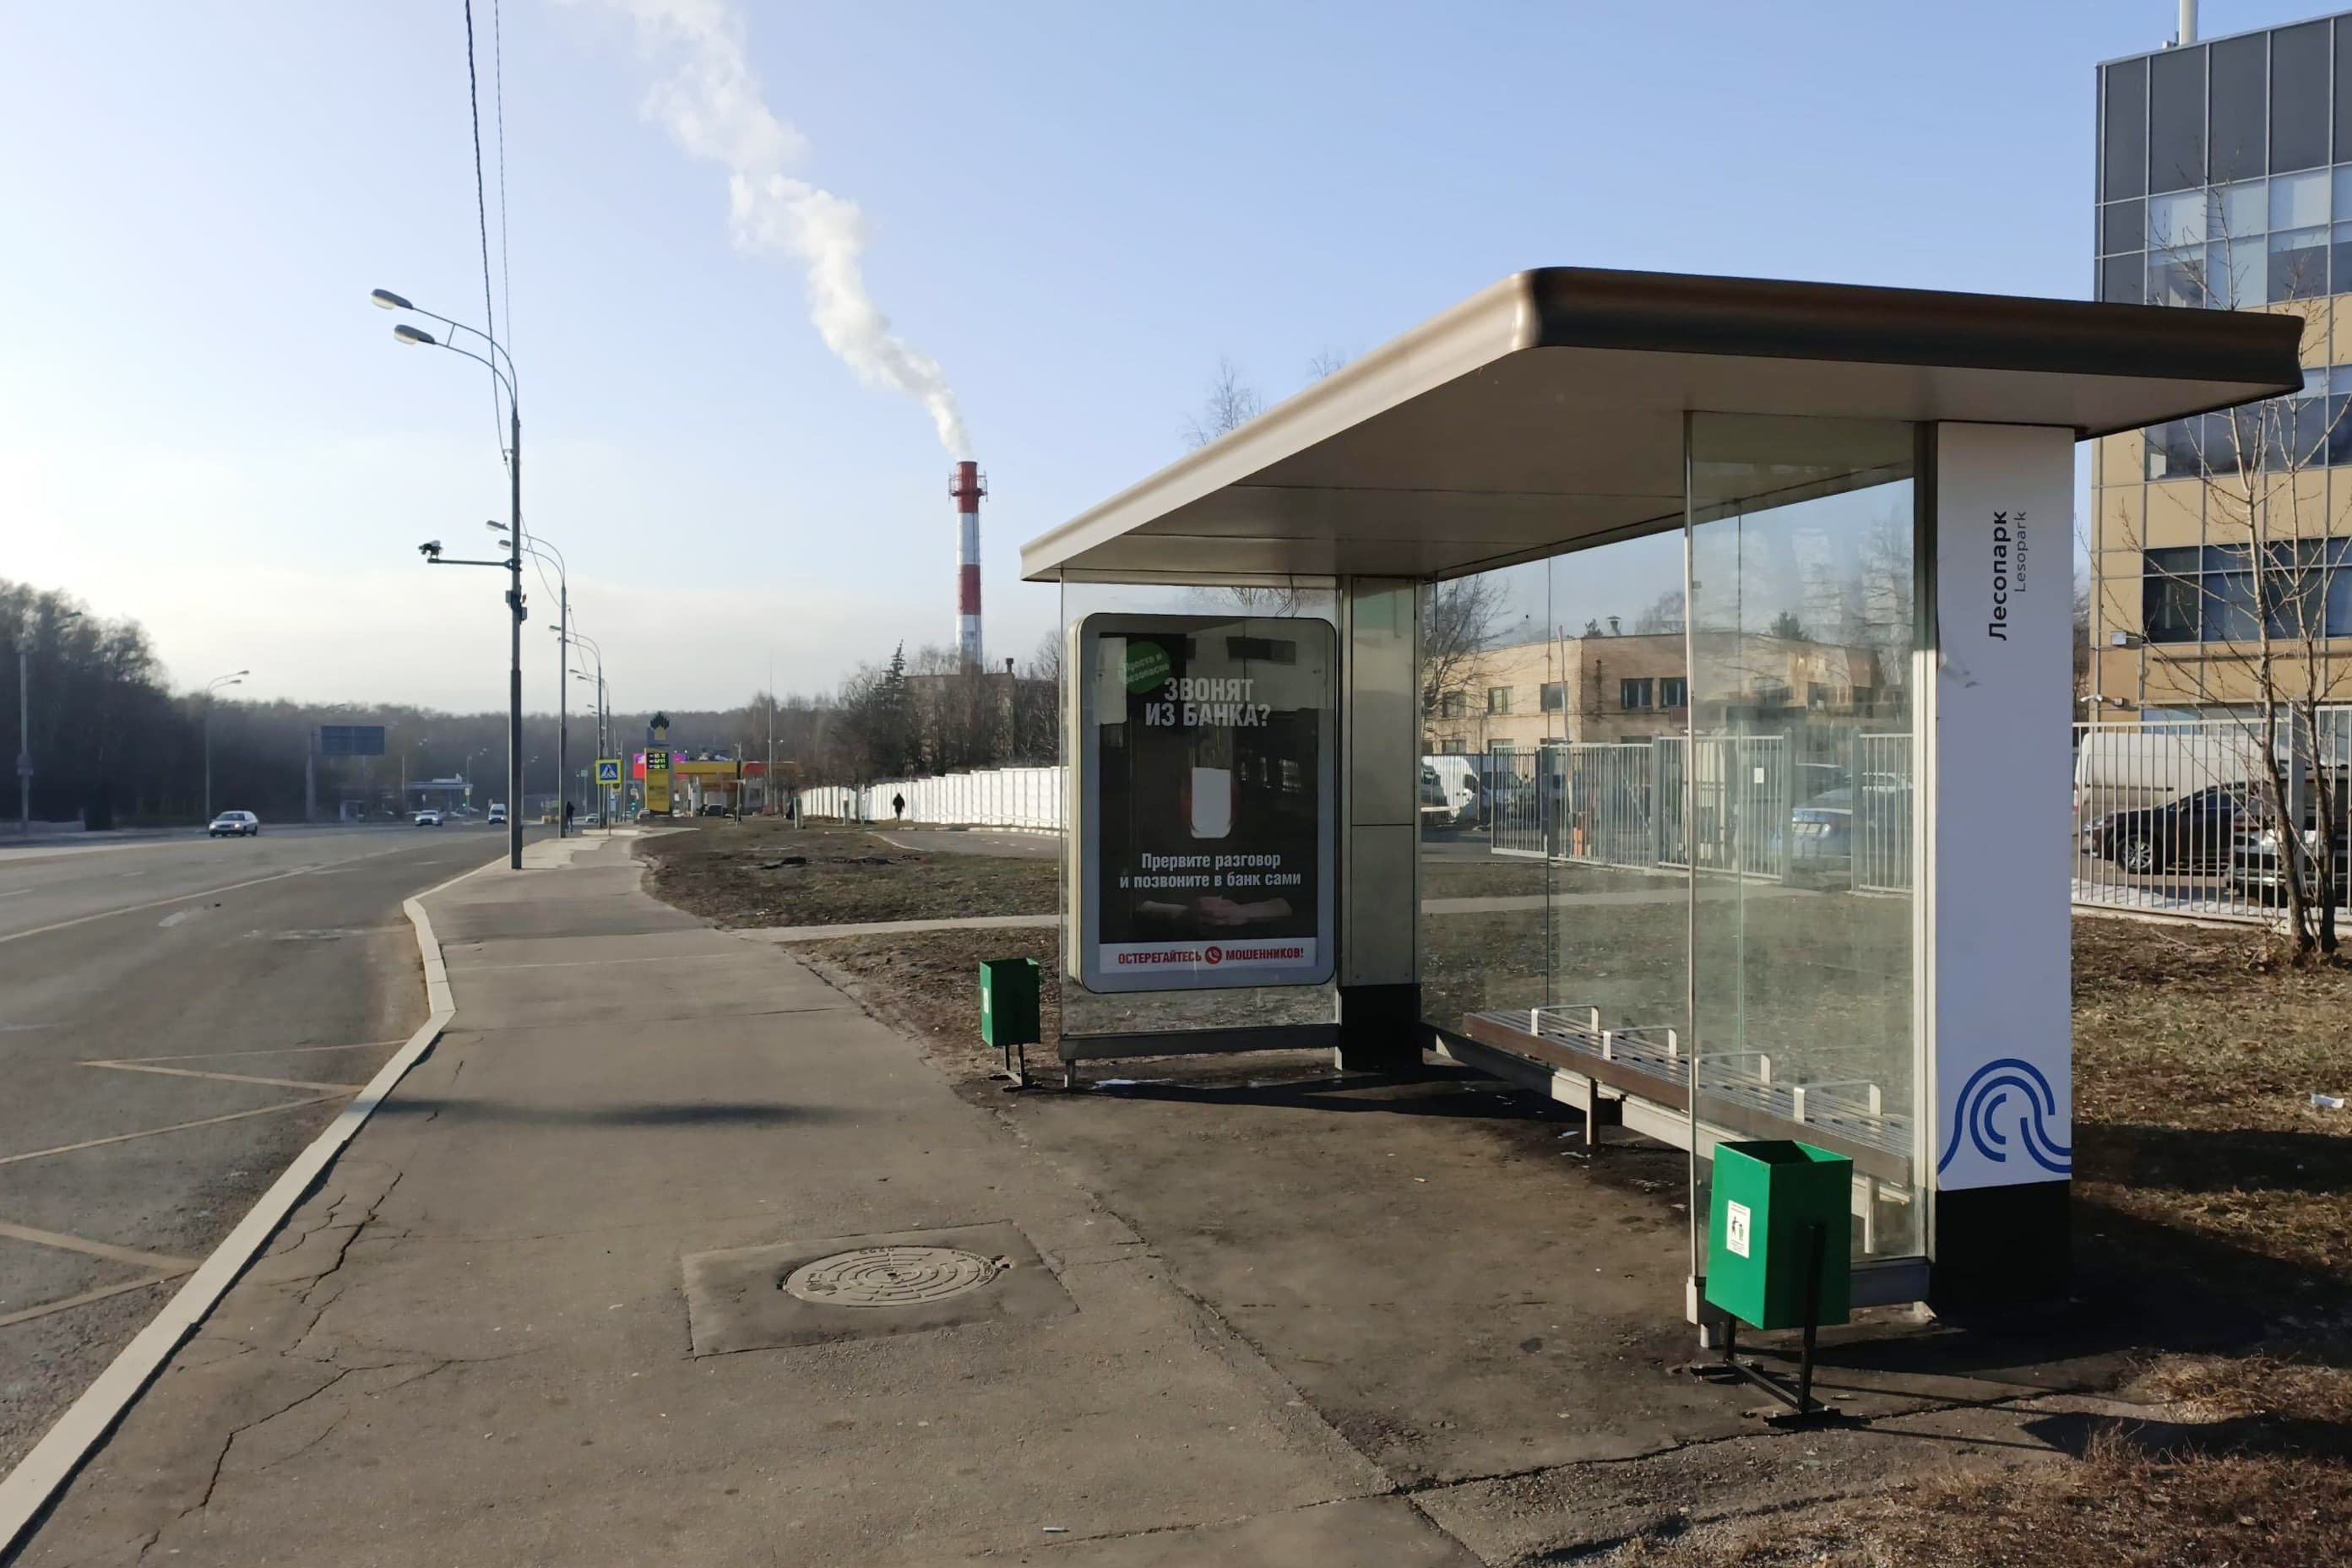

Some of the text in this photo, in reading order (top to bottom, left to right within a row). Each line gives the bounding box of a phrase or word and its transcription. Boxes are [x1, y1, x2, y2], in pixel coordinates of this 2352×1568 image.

[2013, 511, 2029, 592] Lesopark
[1989, 511, 2011, 641] Лесопарк
[1164, 676, 1254, 702] ЗВОНЯТ
[1145, 703, 1271, 727] ИЗ БАНКА?
[1142, 853, 1281, 871] Прервите разговор
[1120, 871, 1301, 888] и позвоните в банк сами
[1118, 947, 1304, 964] ОСТЕРЕГАЙТЕСЬ МОШЕННИКОВ!
